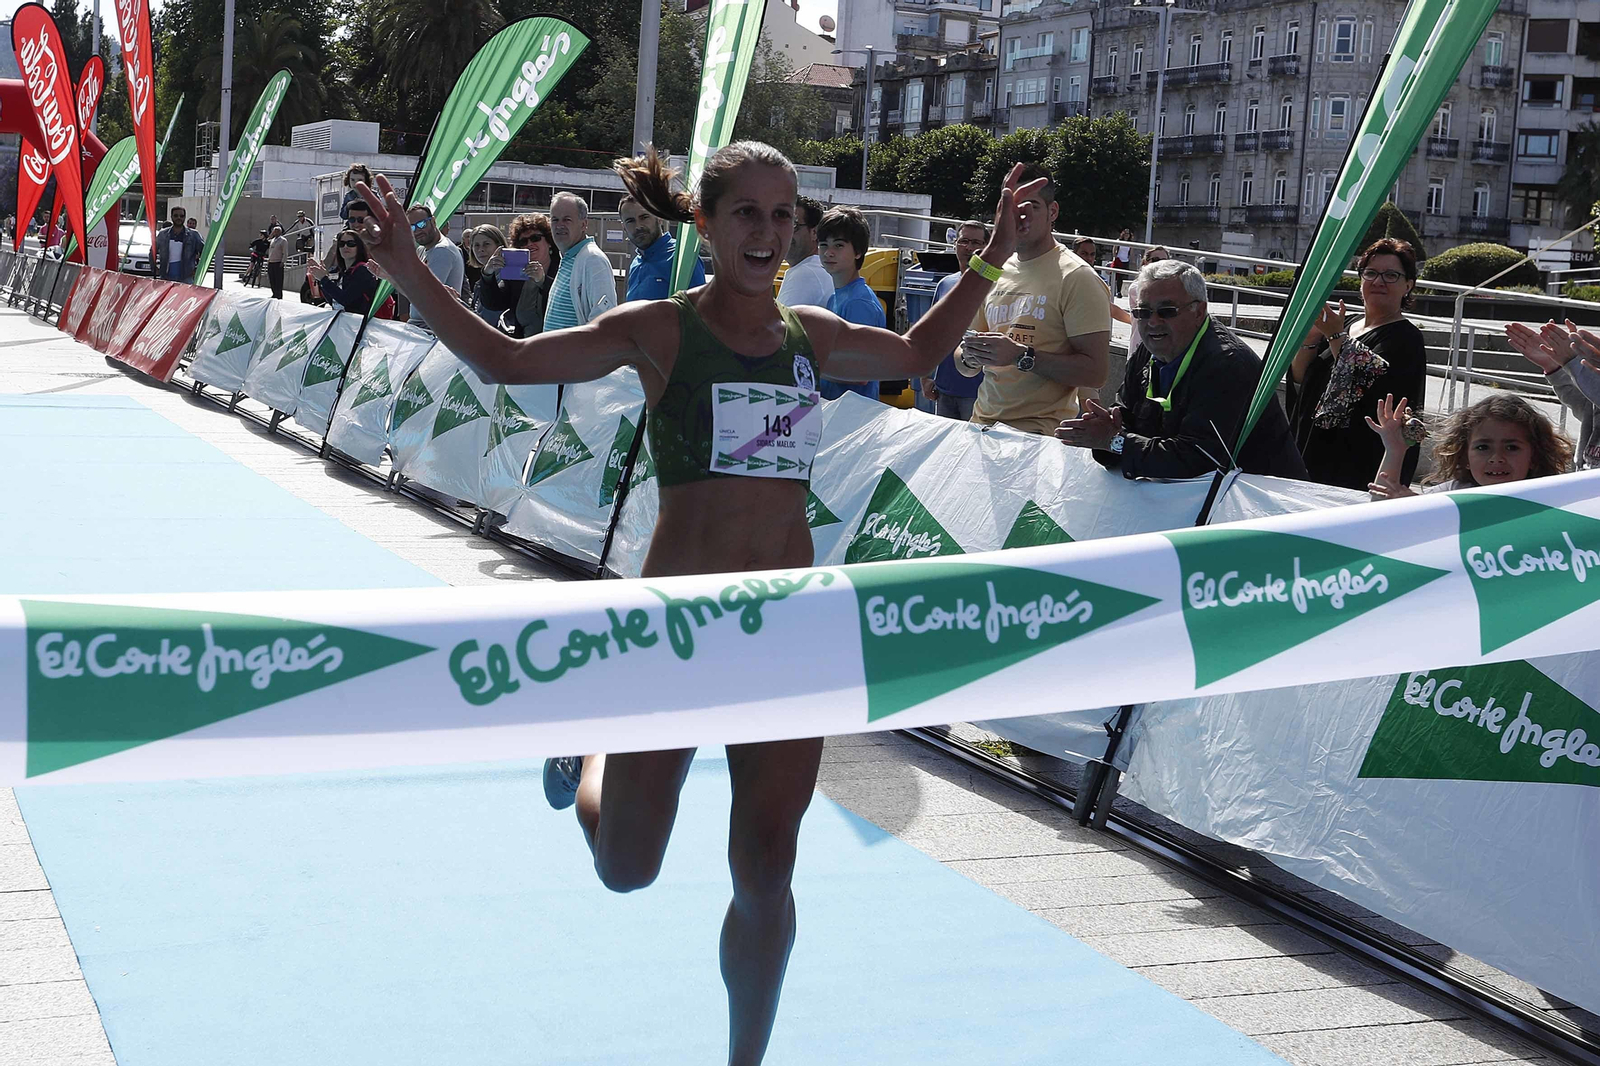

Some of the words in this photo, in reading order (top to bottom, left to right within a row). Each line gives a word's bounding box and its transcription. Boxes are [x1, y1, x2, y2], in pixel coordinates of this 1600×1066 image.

[477, 31, 571, 142] Inglés
[763, 414, 792, 437] 143
[1187, 572, 1217, 610] El
[1219, 571, 1288, 605] Corte
[1292, 557, 1389, 614] Inglés
[1466, 546, 1503, 578] El
[1498, 544, 1568, 577] Corte
[449, 639, 520, 706] El
[516, 607, 659, 683] Corte
[645, 571, 836, 661] Inglés
[866, 596, 902, 636] El
[903, 595, 981, 634] Corte
[985, 581, 1093, 644] Inglés
[36, 632, 84, 679] El
[86, 634, 192, 678] Corte
[197, 623, 344, 692] Inglés
[1404, 670, 1437, 708] El
[1434, 680, 1506, 734] Corte
